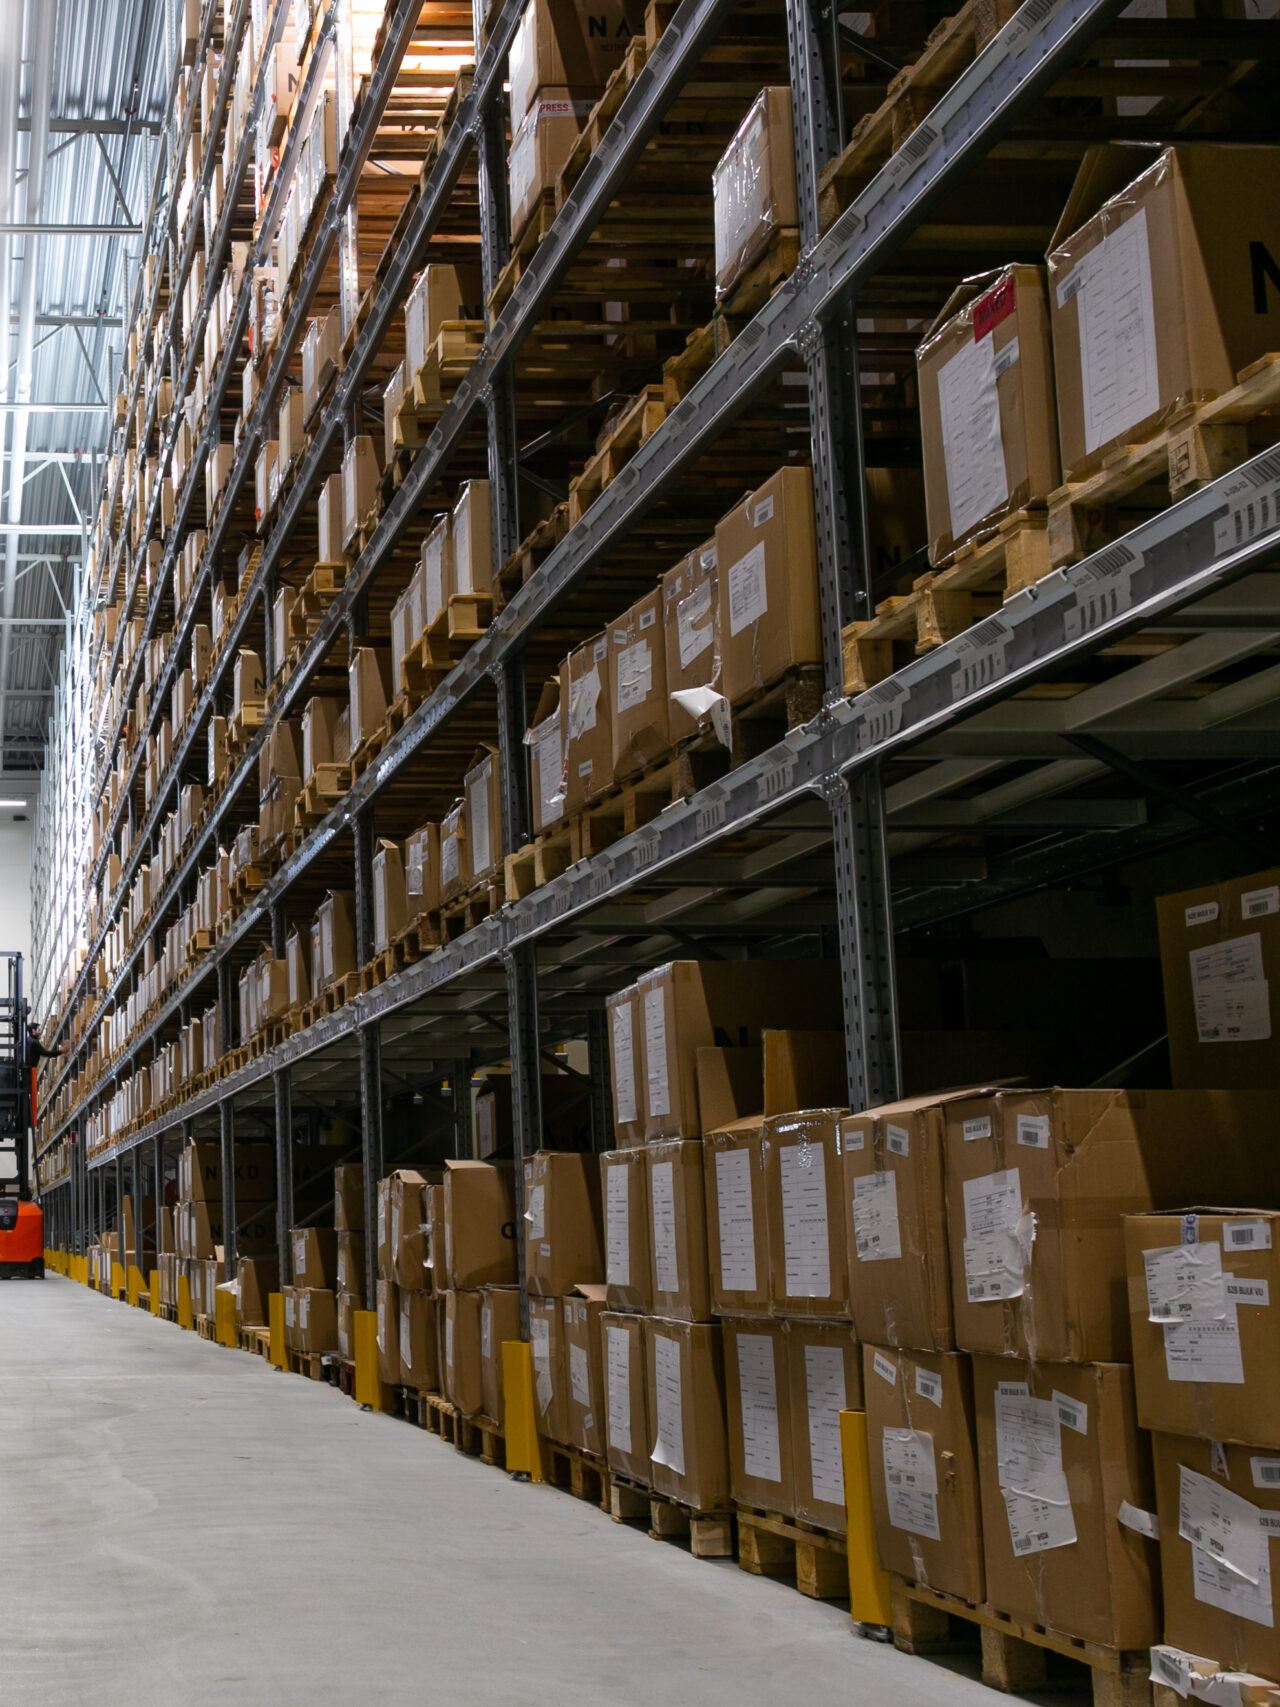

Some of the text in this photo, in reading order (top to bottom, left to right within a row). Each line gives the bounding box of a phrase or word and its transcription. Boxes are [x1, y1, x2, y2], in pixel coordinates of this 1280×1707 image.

[540, 103, 568, 112] PRESS
[1227, 1285, 1264, 1297] B2B BULK VU
